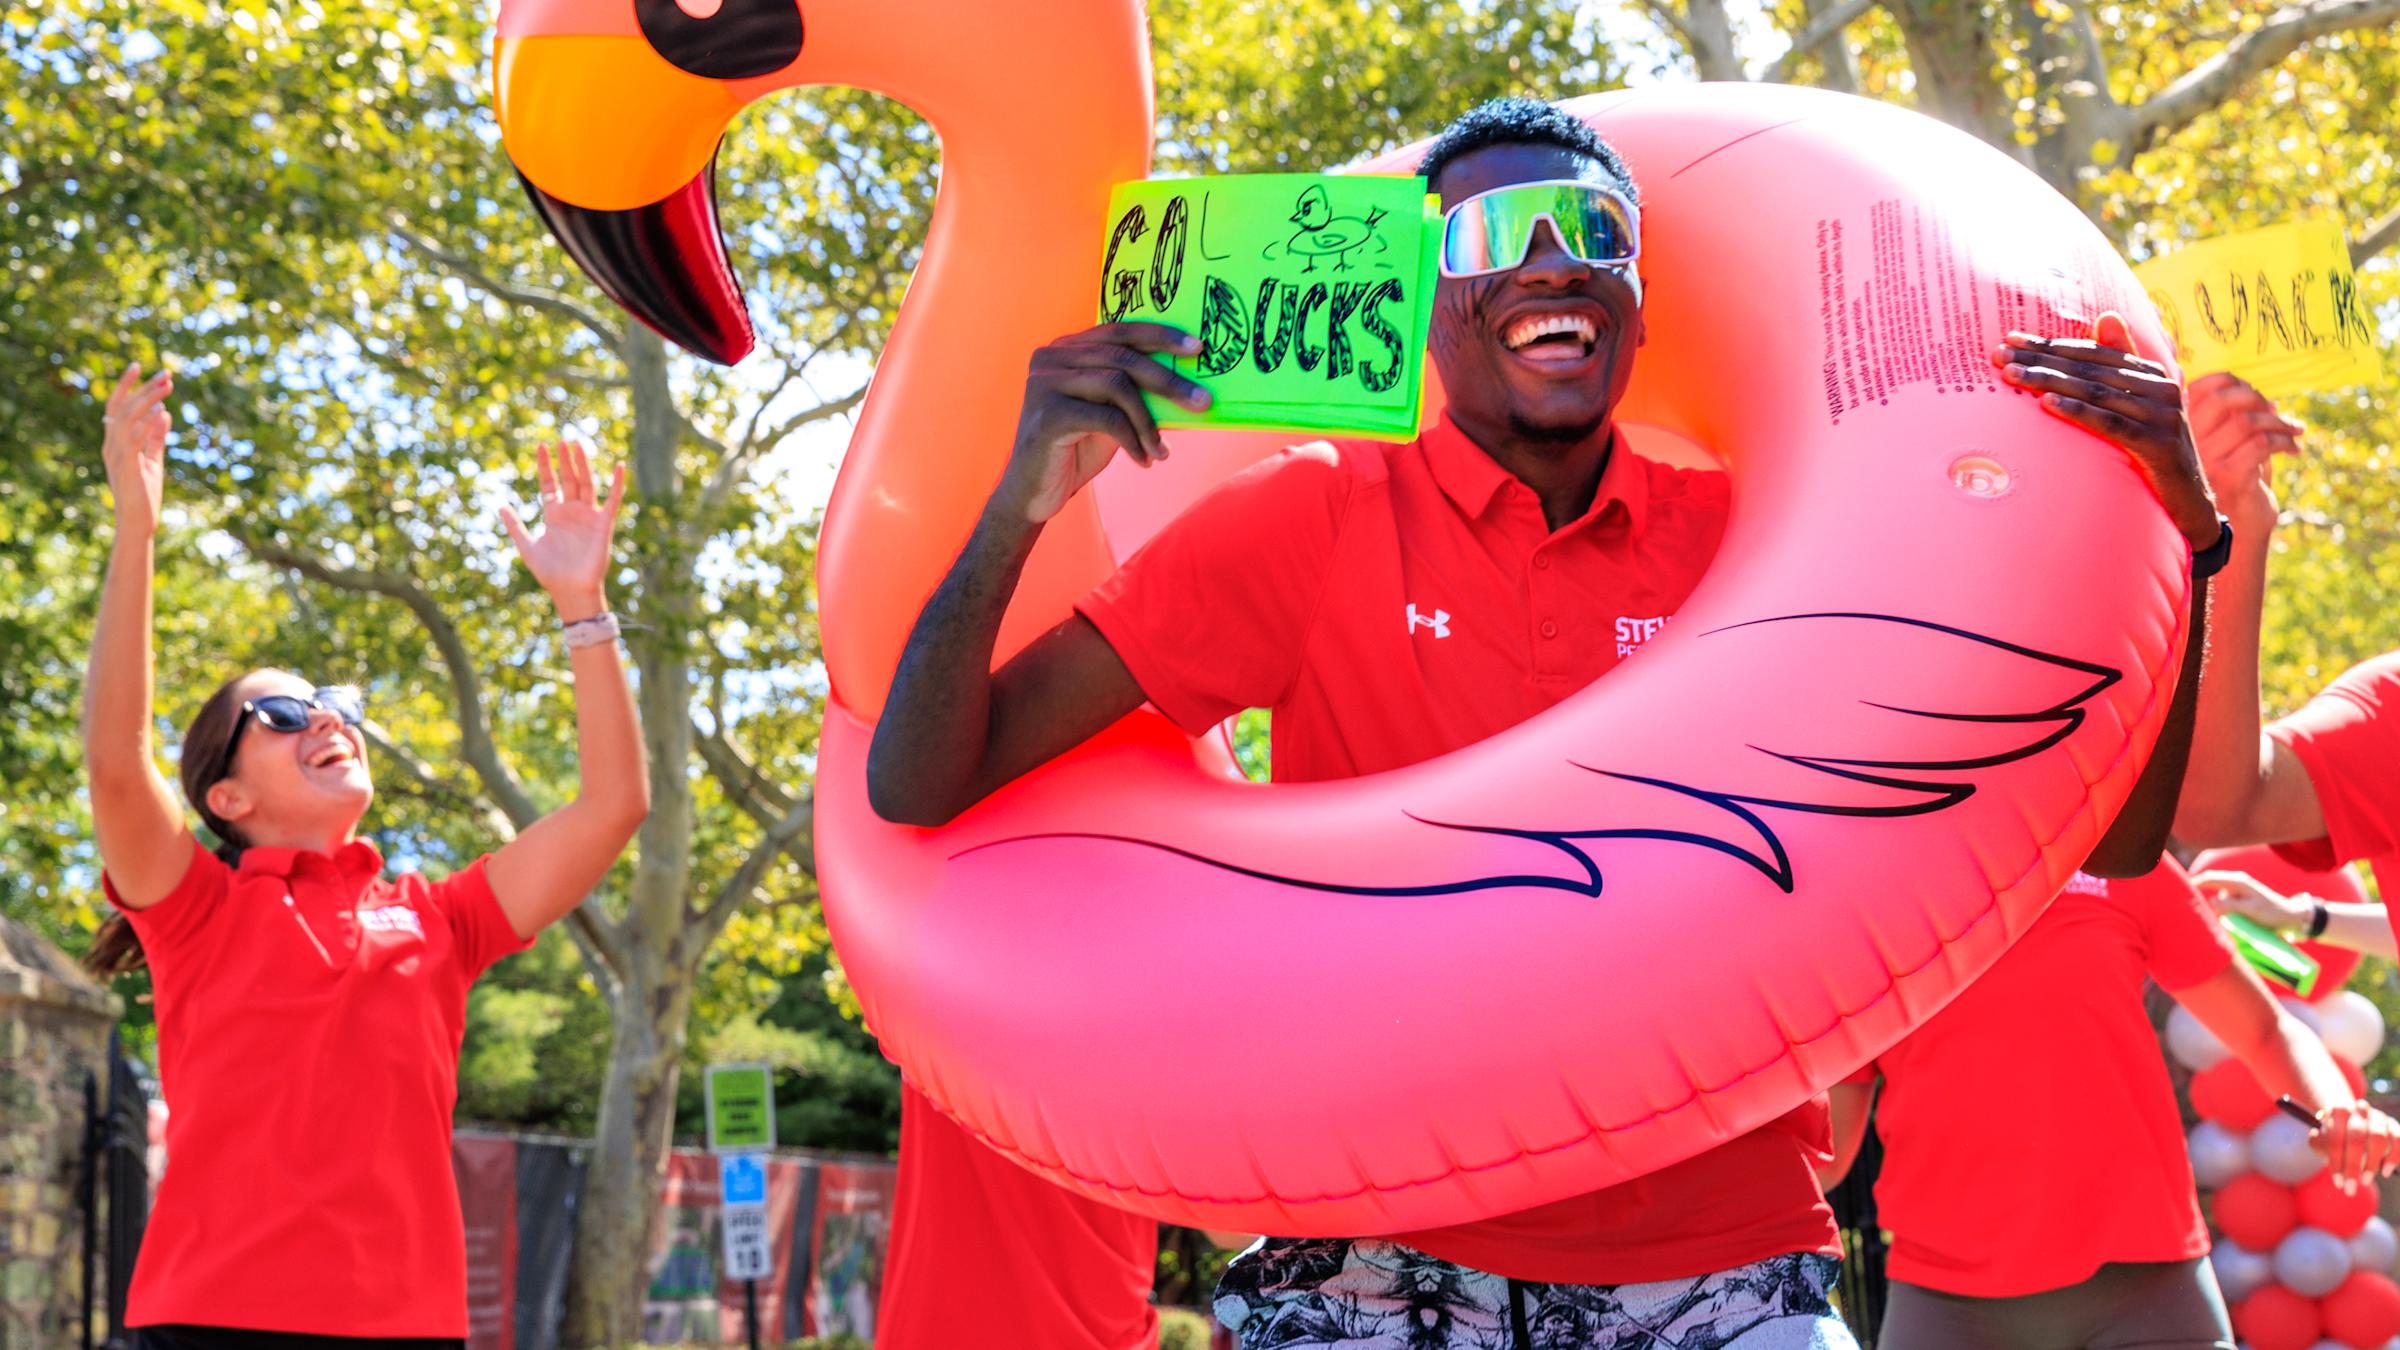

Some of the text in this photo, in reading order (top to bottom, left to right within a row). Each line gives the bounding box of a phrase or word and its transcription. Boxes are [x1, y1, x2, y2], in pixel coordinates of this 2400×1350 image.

[1816, 229, 1829, 248] Only
[1101, 195, 1188, 325] GO
[1196, 274, 1404, 393] DUCKS
[1841, 348, 1851, 370] water
[1854, 341, 1867, 363] adult
[1859, 363, 1871, 386] under
[1823, 359, 1844, 418] WARNING!
[1843, 378, 1857, 397] used
[1861, 386, 1875, 402] and
[1848, 397, 1860, 410] be
[1616, 642, 1641, 659] PE
